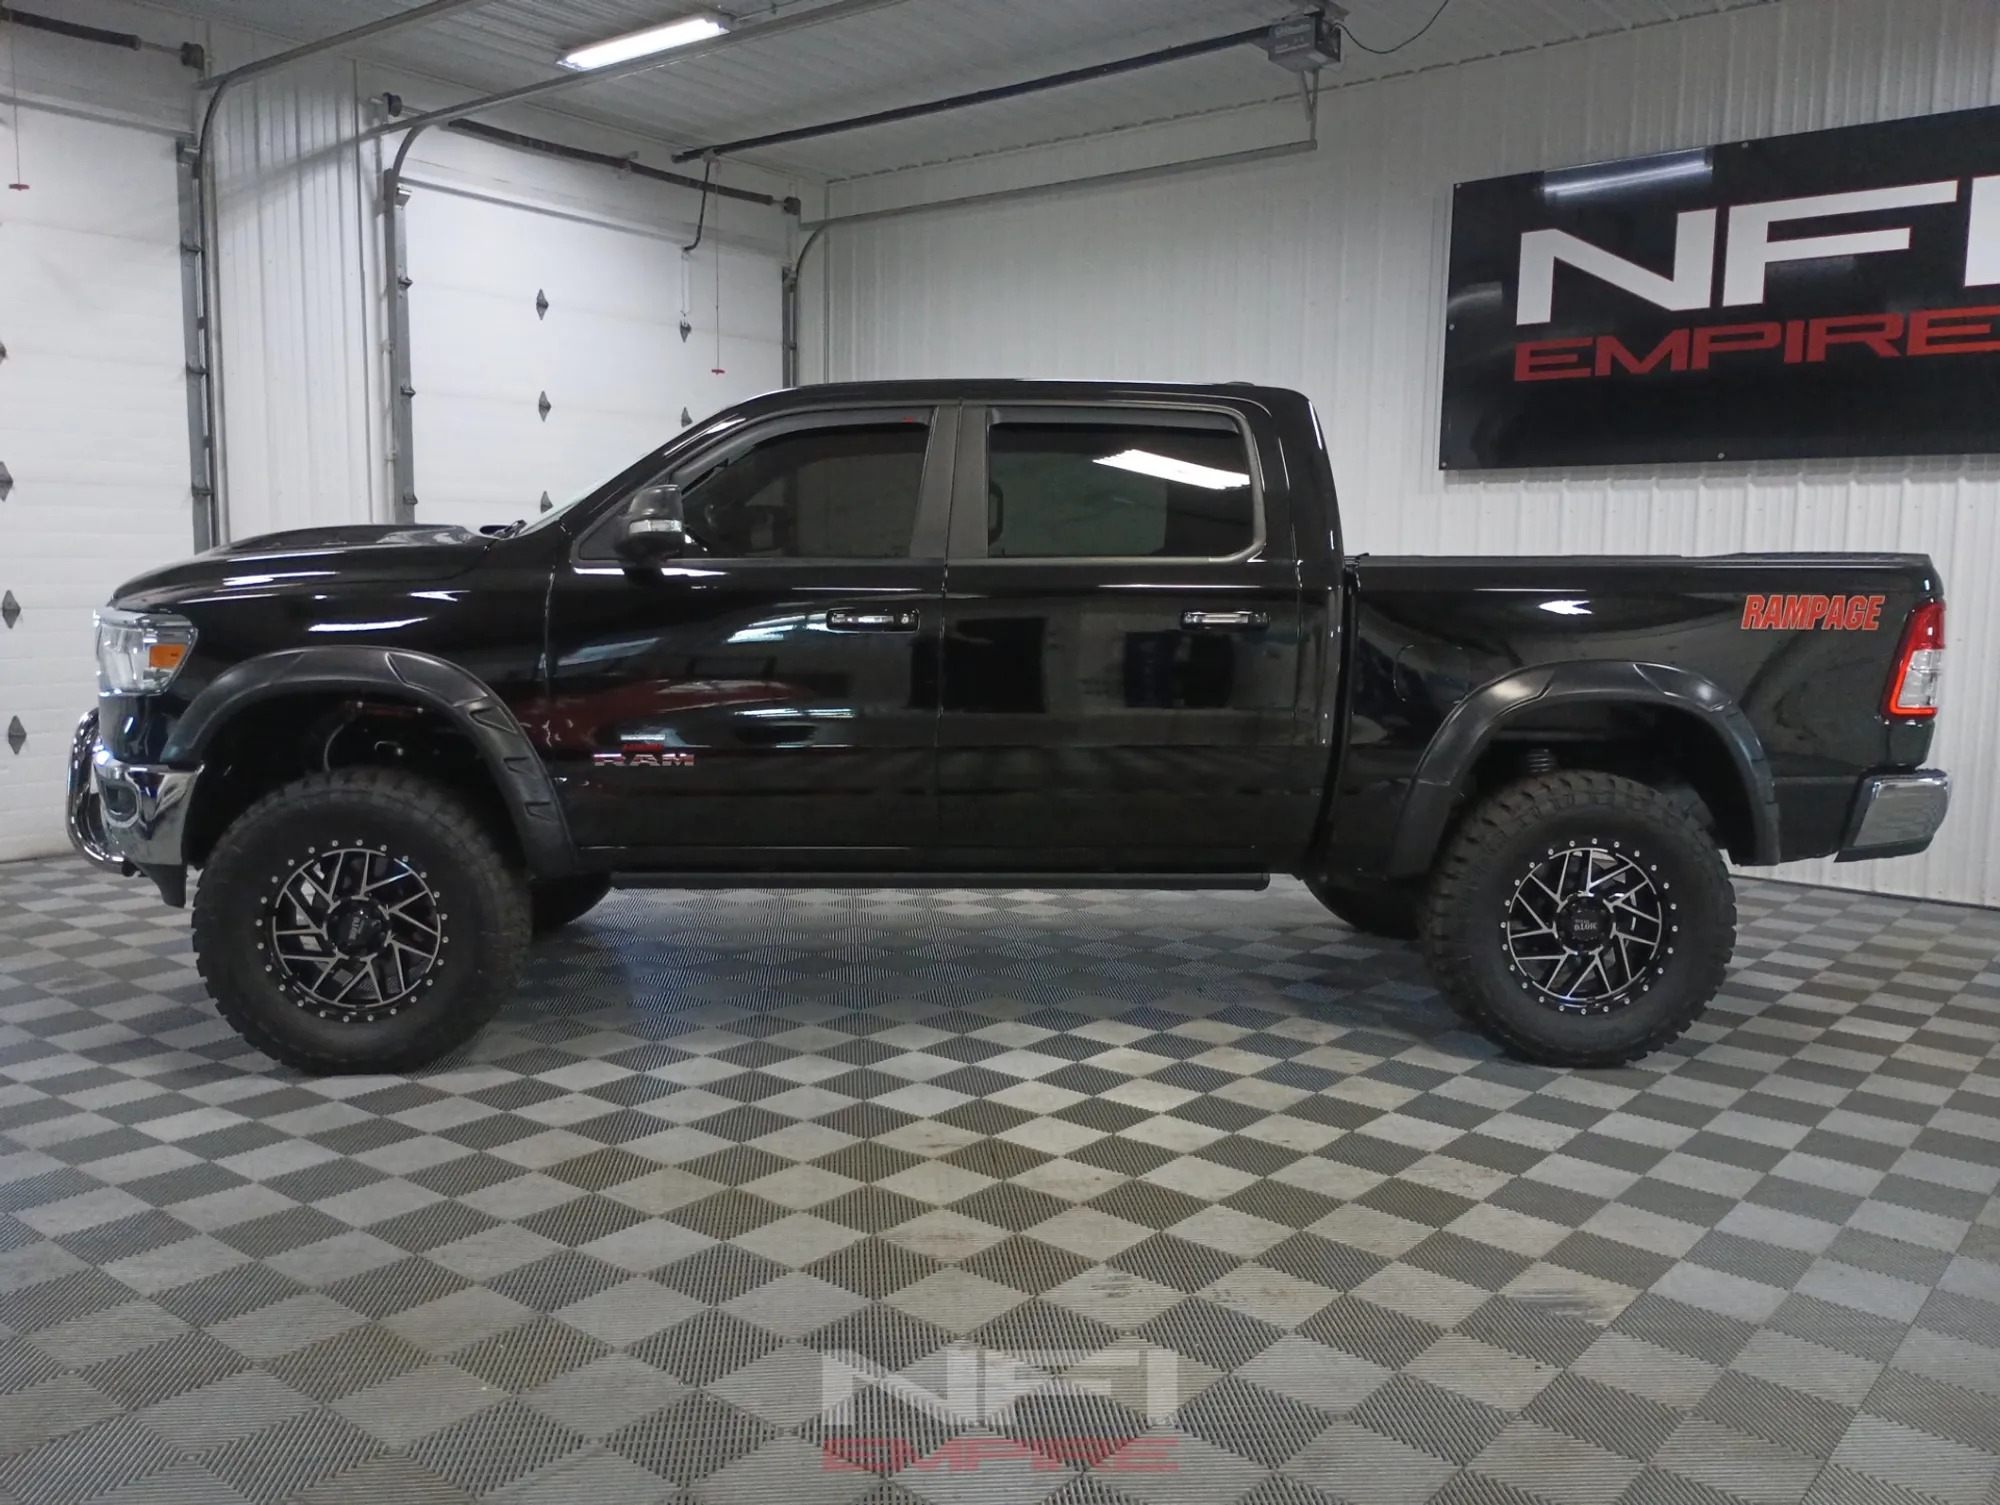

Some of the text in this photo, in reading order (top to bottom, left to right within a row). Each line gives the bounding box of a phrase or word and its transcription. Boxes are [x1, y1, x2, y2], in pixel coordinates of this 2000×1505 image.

[1515, 305, 2000, 381] EMPIRE
[1741, 594, 1885, 630] RAMPAGE
[594, 753, 695, 766] RAM
